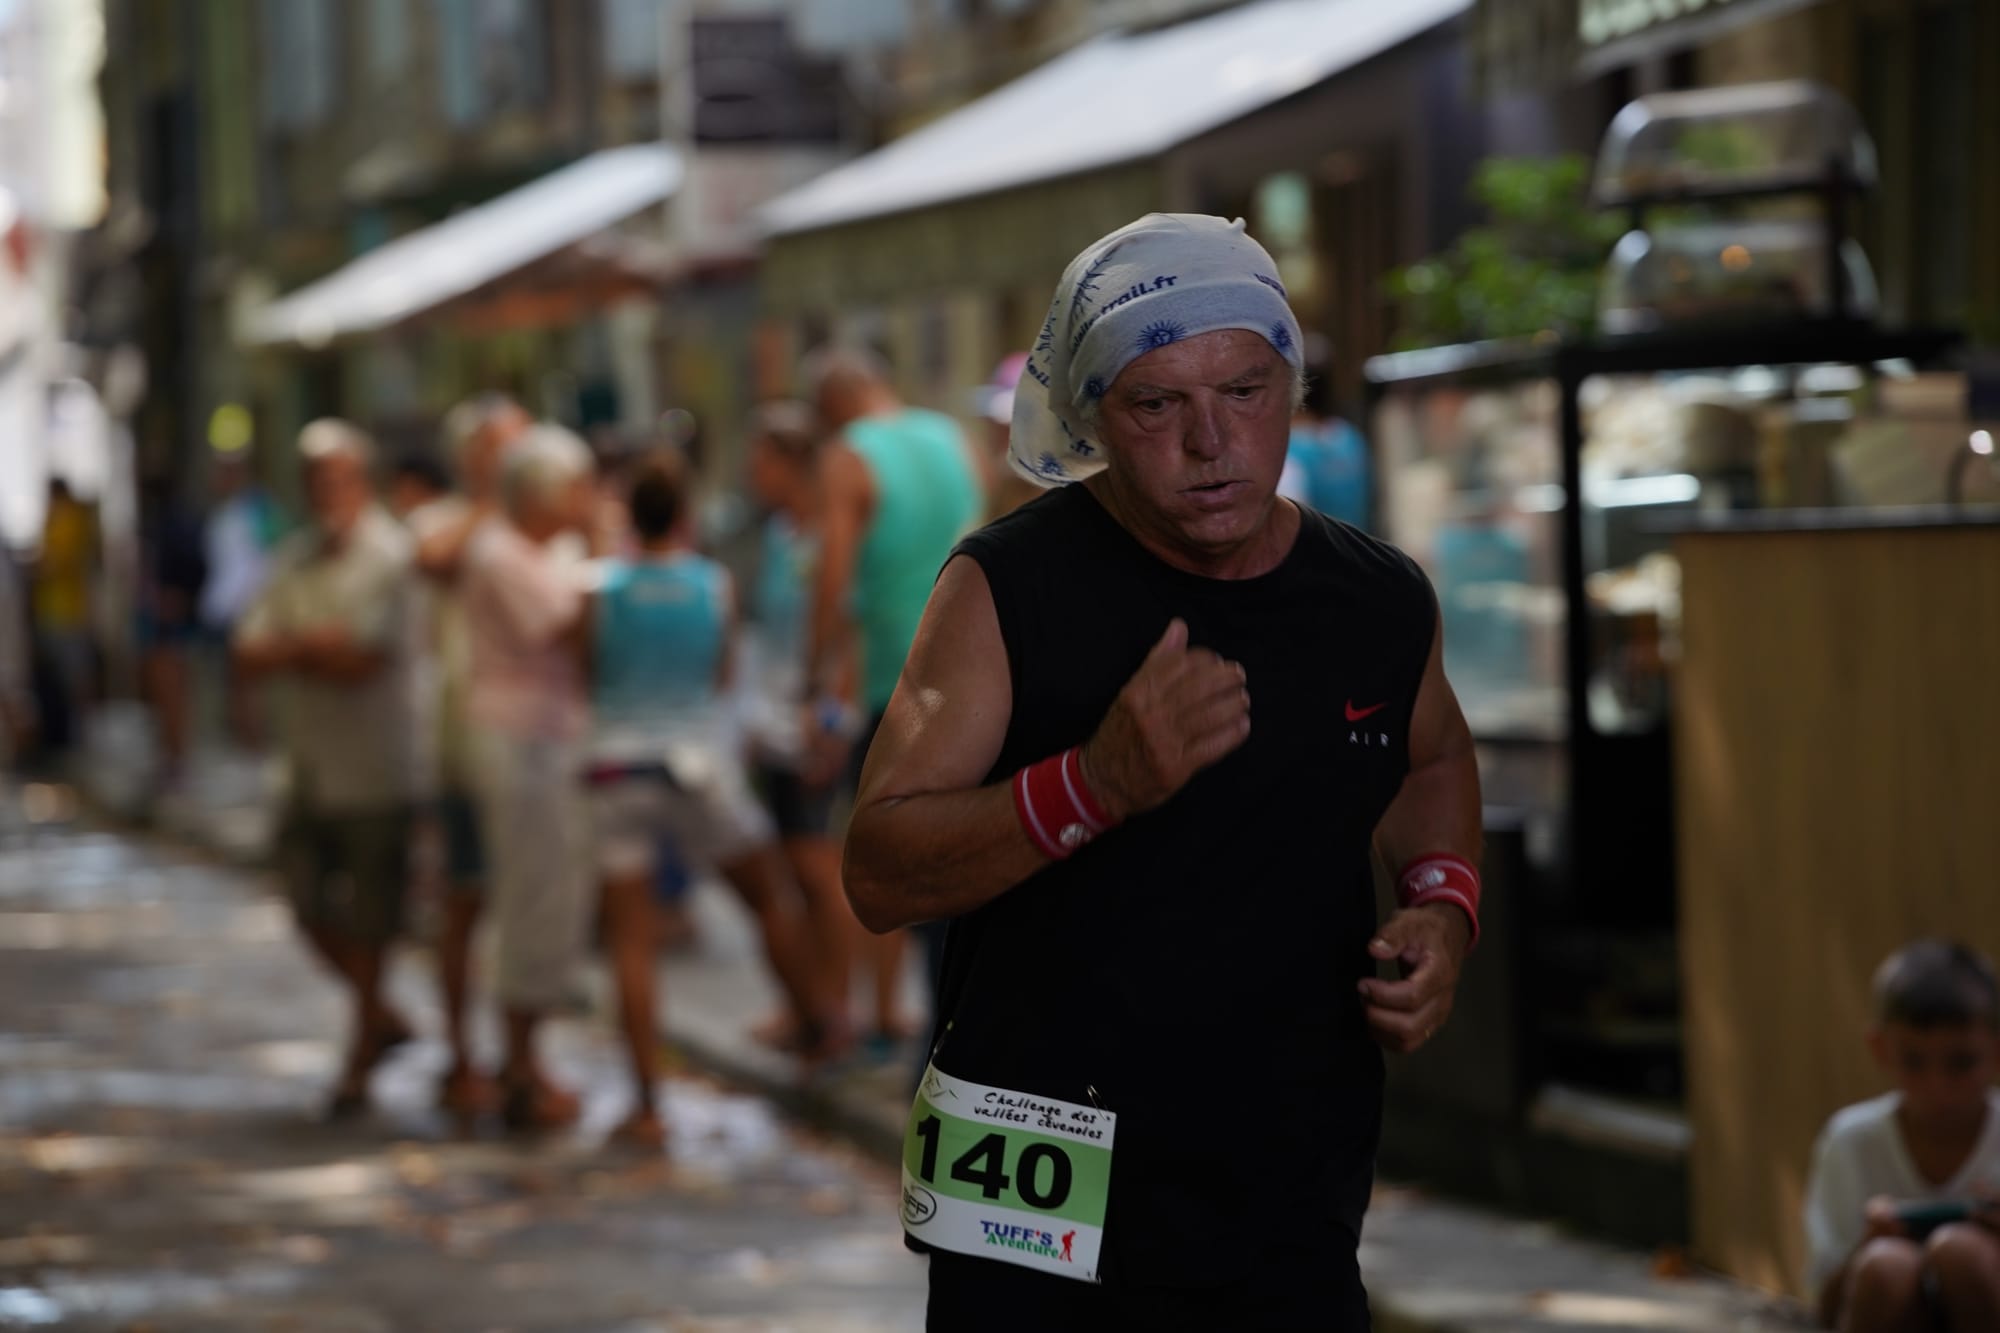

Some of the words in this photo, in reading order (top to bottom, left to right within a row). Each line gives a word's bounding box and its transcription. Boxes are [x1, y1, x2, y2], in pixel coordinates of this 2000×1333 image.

[1348, 730, 1390, 748] AIR
[974, 1106, 1029, 1123] vallées
[1037, 1117, 1103, 1139] cévenoles
[984, 1092, 1061, 1117] Challenge
[1071, 1111, 1096, 1124] des
[917, 1114, 1072, 1210] 140
[980, 1220, 1053, 1246] TUFF'S
[986, 1232, 1059, 1258] Aventure
